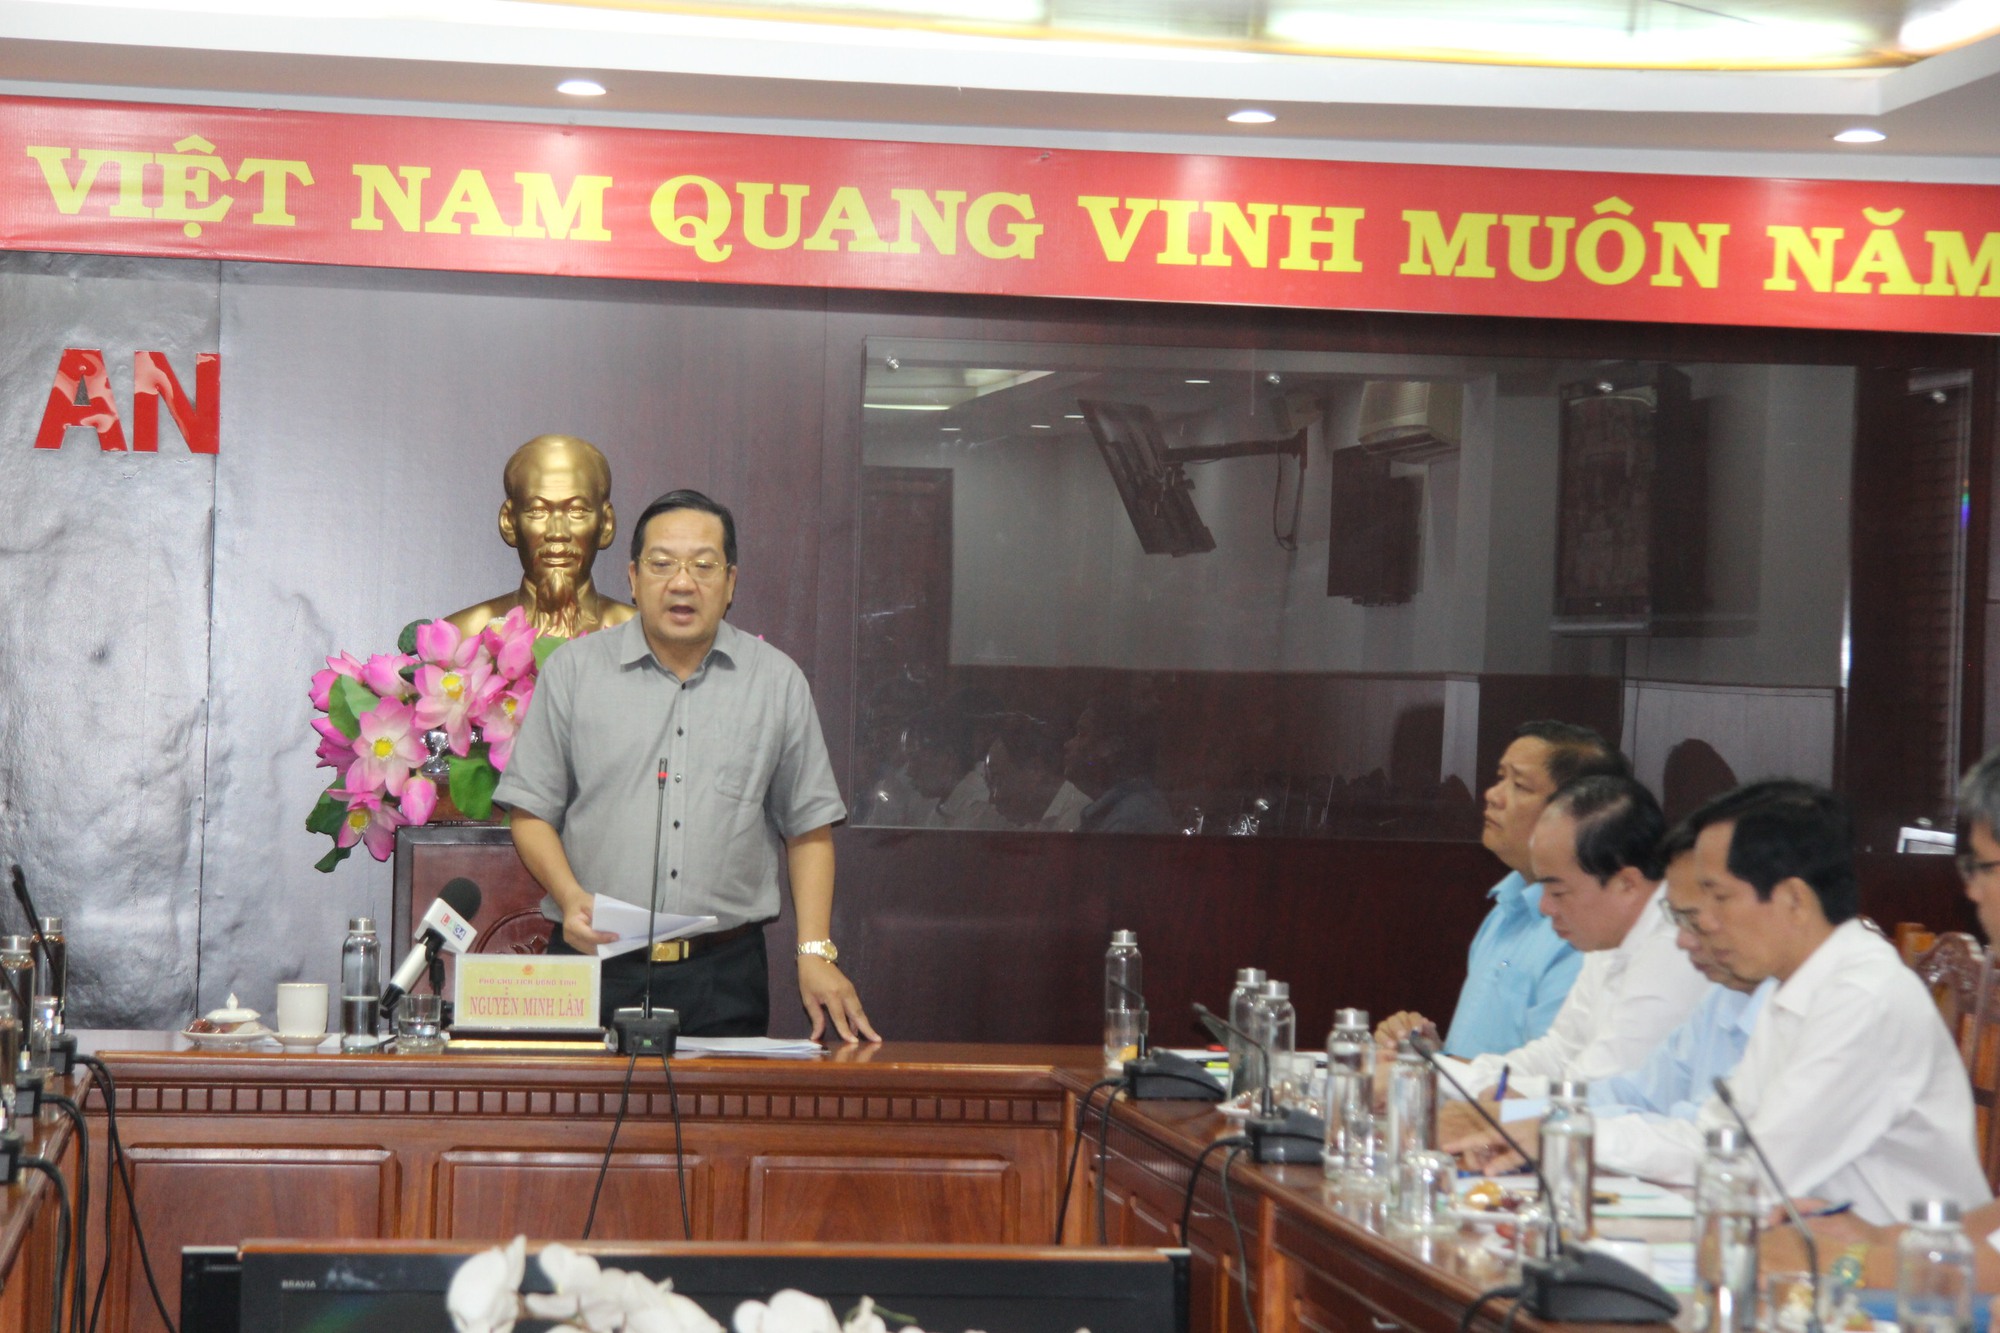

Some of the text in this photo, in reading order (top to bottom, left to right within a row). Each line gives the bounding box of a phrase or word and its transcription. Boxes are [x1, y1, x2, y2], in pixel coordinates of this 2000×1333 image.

[26, 133, 2000, 298] VIỆT NAM QUANG VINH MUÔN NĂM
[33, 347, 221, 454] AN
[522, 997, 555, 1017] MINH
[558, 992, 585, 1017] LÂM
[281, 1279, 317, 1290] BRAVIA
